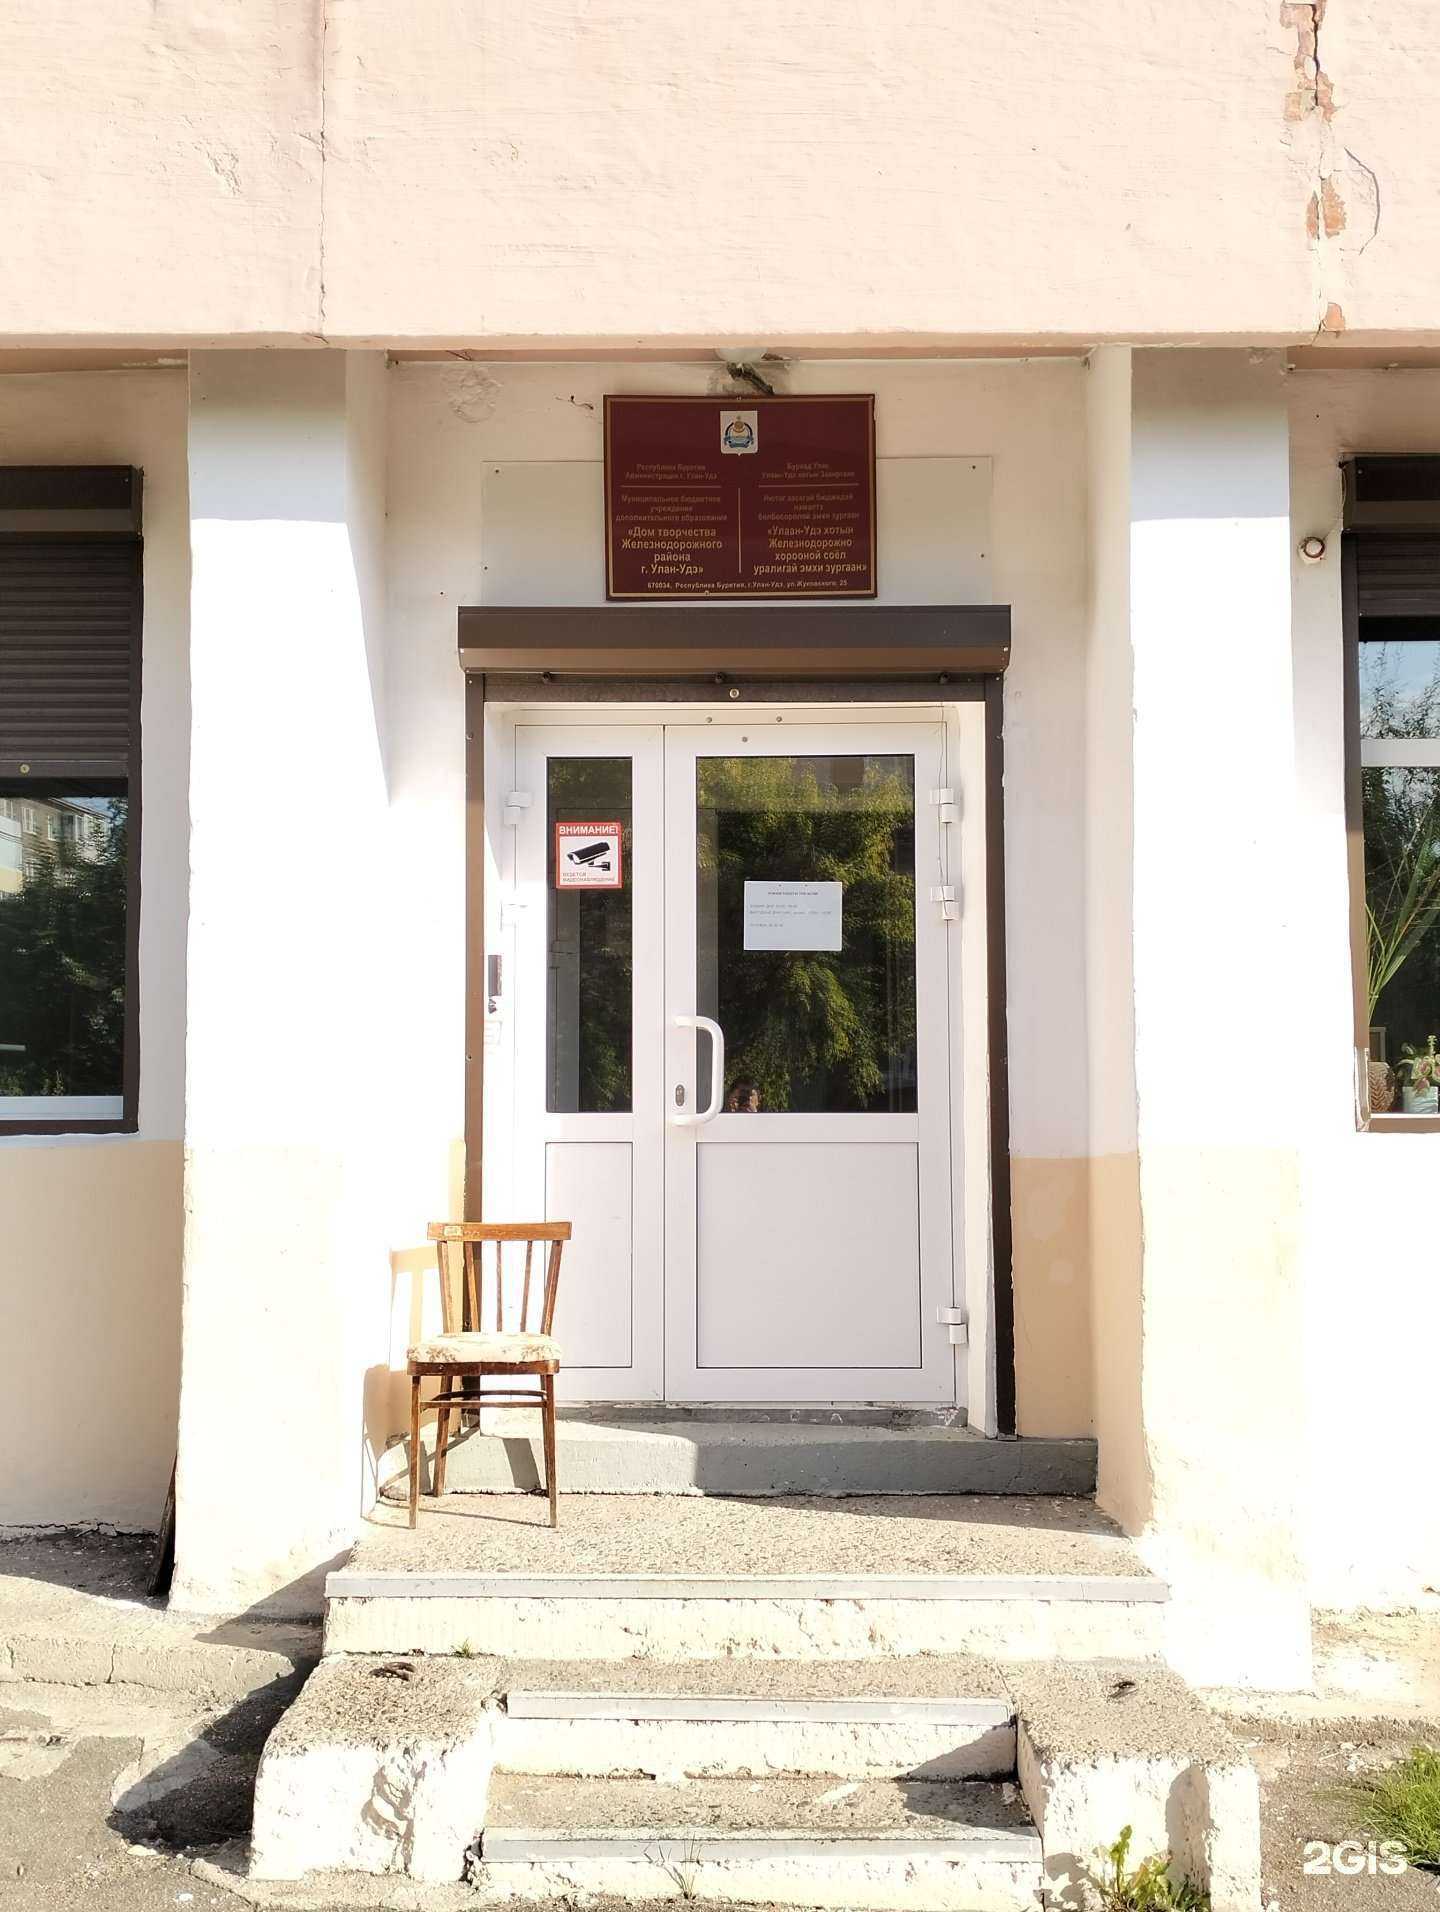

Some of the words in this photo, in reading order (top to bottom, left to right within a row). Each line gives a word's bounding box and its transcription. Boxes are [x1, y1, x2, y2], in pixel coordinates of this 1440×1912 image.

[621, 495, 679, 504] Муниципальное
[650, 505, 693, 514] учреждение
[615, 513, 680, 522] дополнительного
[628, 526, 655, 538] «Дом
[658, 528, 717, 538] творчества
[768, 525, 821, 536] «Улаан-Удэ
[823, 526, 854, 535] хотын
[622, 538, 723, 551] Железнодорожного
[768, 538, 853, 550] Железнодорожно
[654, 551, 691, 563] района
[775, 550, 821, 562] хорооной
[641, 566, 648, 574] г.
[650, 563, 704, 576] Улан-Удэ»
[753, 562, 798, 576] уралигай
[799, 563, 824, 573] эмхи
[825, 563, 867, 575] зургаан»
[675, 581, 715, 591] Республика
[559, 825, 618, 835] ВНИМАНИЕ!
